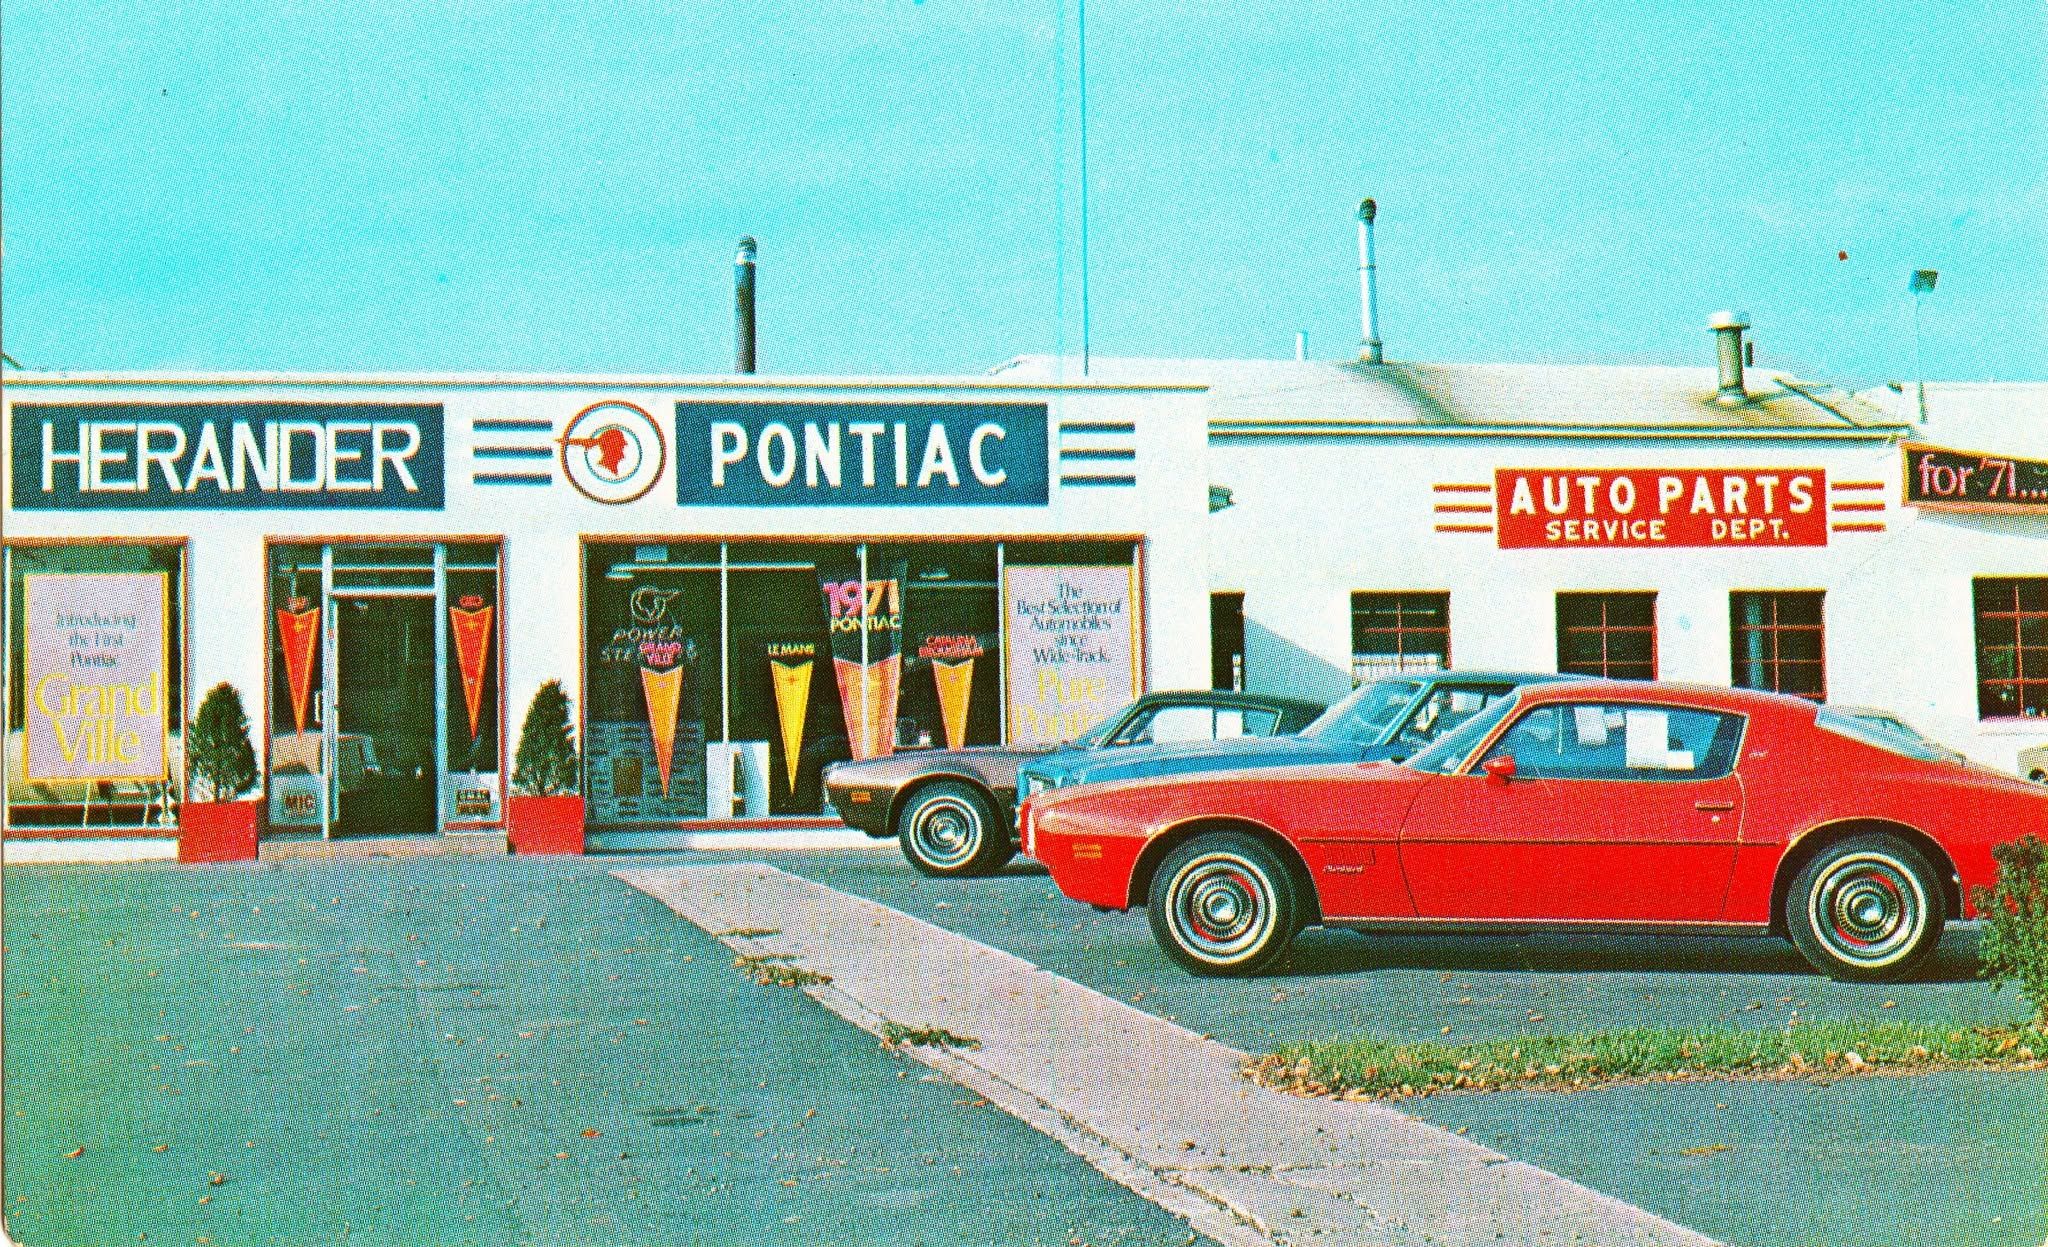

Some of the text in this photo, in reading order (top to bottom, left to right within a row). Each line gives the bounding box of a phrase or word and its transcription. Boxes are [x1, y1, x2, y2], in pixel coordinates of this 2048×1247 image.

[42, 421, 421, 492] HERANDER
[711, 422, 1007, 488] PONTIAC
[1918, 454, 1974, 496] for
[1510, 474, 1814, 514] AUTO PARTS
[1545, 518, 1790, 541] SERVICE DEPT.
[823, 578, 900, 617] 1971
[1016, 598, 1122, 614] Best Selection of
[1058, 582, 1083, 598] The
[56, 612, 137, 629] Introducing
[831, 615, 901, 633] PONTIAC
[1030, 616, 1112, 631] Automobiles
[34, 672, 159, 716] Grand
[1038, 668, 1105, 703] Pure
[52, 719, 142, 764] Ville
